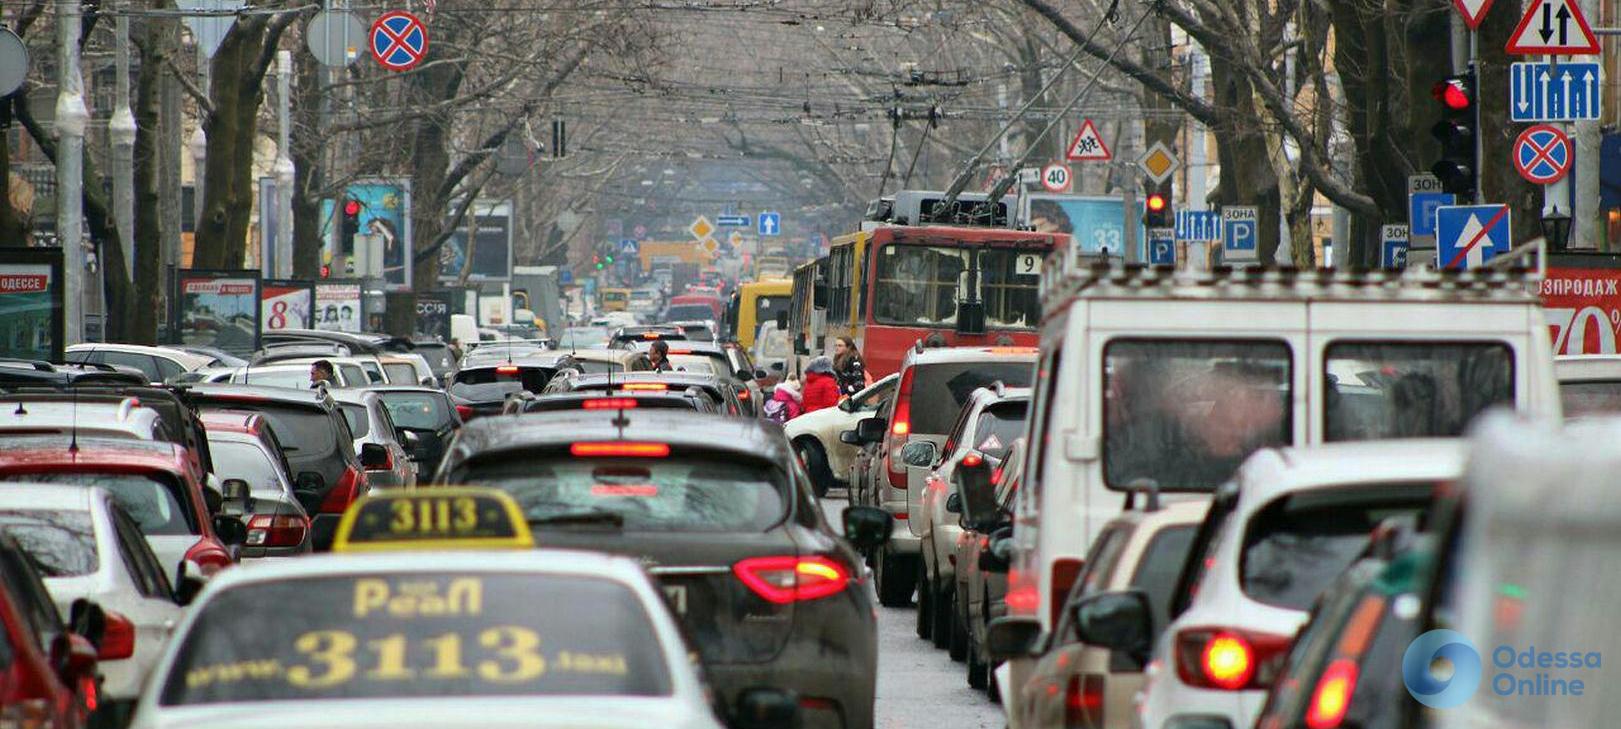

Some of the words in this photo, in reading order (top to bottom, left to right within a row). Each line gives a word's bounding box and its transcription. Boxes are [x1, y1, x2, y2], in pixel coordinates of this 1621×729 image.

[1047, 169, 1066, 184] 40
[1414, 180, 1442, 190] ЗОН
[1225, 210, 1255, 219] ЗОНА
[1233, 223, 1250, 248] P
[1386, 227, 1408, 238] ЗОН
[1024, 256, 1034, 272] 9
[1, 278, 40, 289] ОДЕССЕ
[1536, 279, 1618, 296] ОЗПРОДАЖ
[268, 301, 287, 329] 8
[390, 498, 477, 532] 3113
